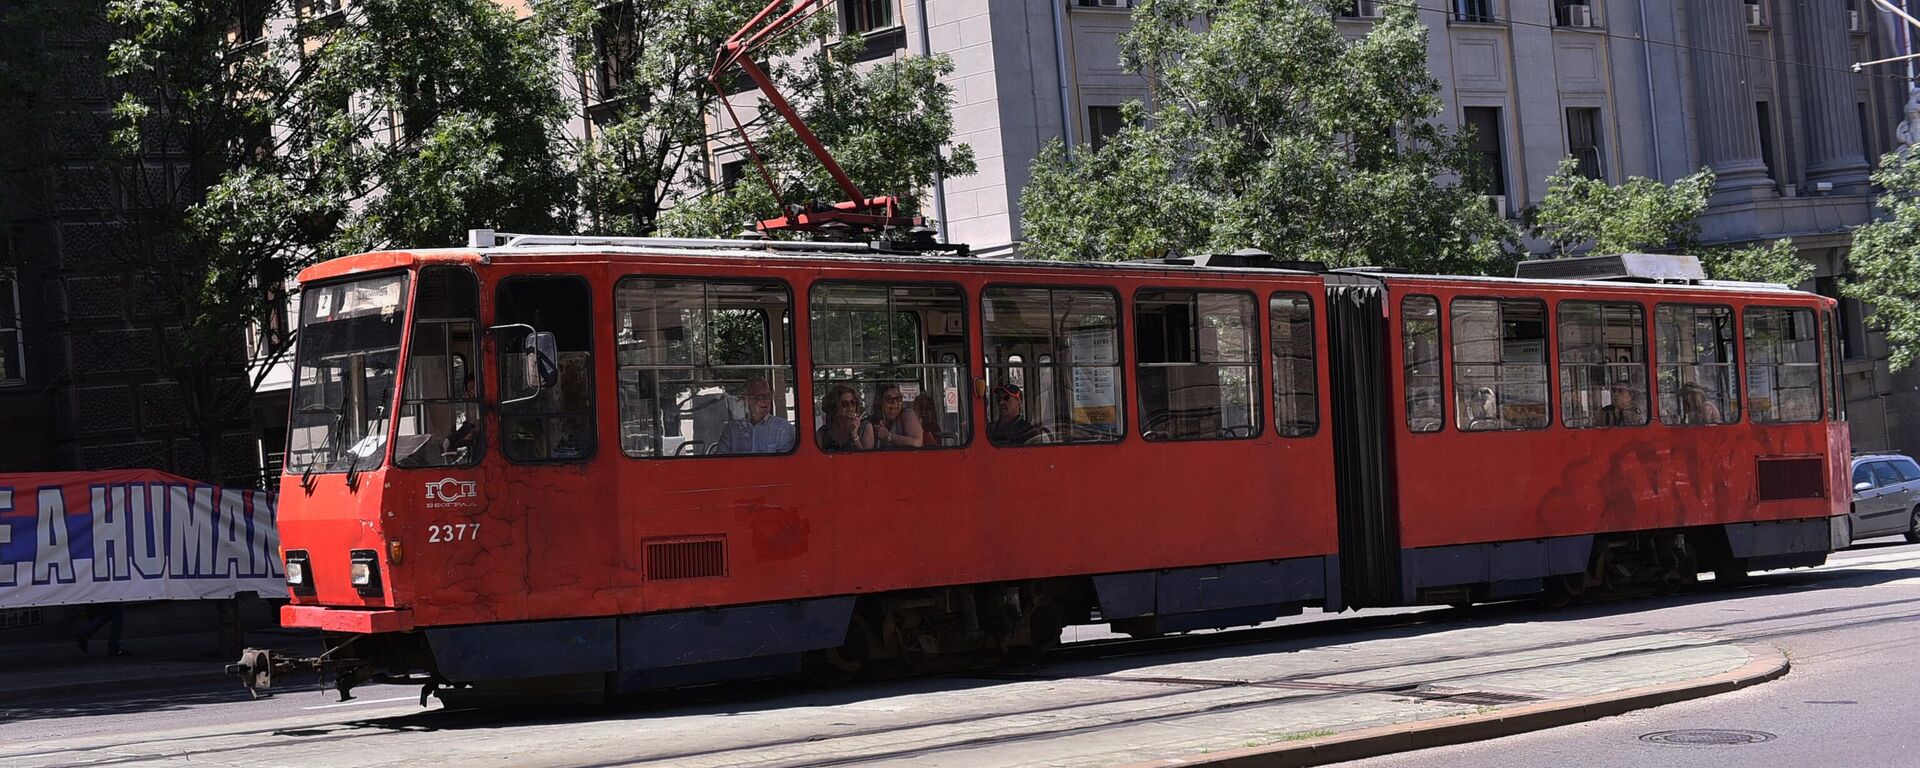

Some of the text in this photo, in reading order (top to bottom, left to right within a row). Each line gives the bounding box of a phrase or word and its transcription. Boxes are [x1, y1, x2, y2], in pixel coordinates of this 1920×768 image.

[322, 295, 328, 309] 2
[425, 477, 477, 502] ГСП
[32, 486, 76, 585] A
[88, 482, 285, 581] HUMAN
[428, 523, 481, 543] 2377
